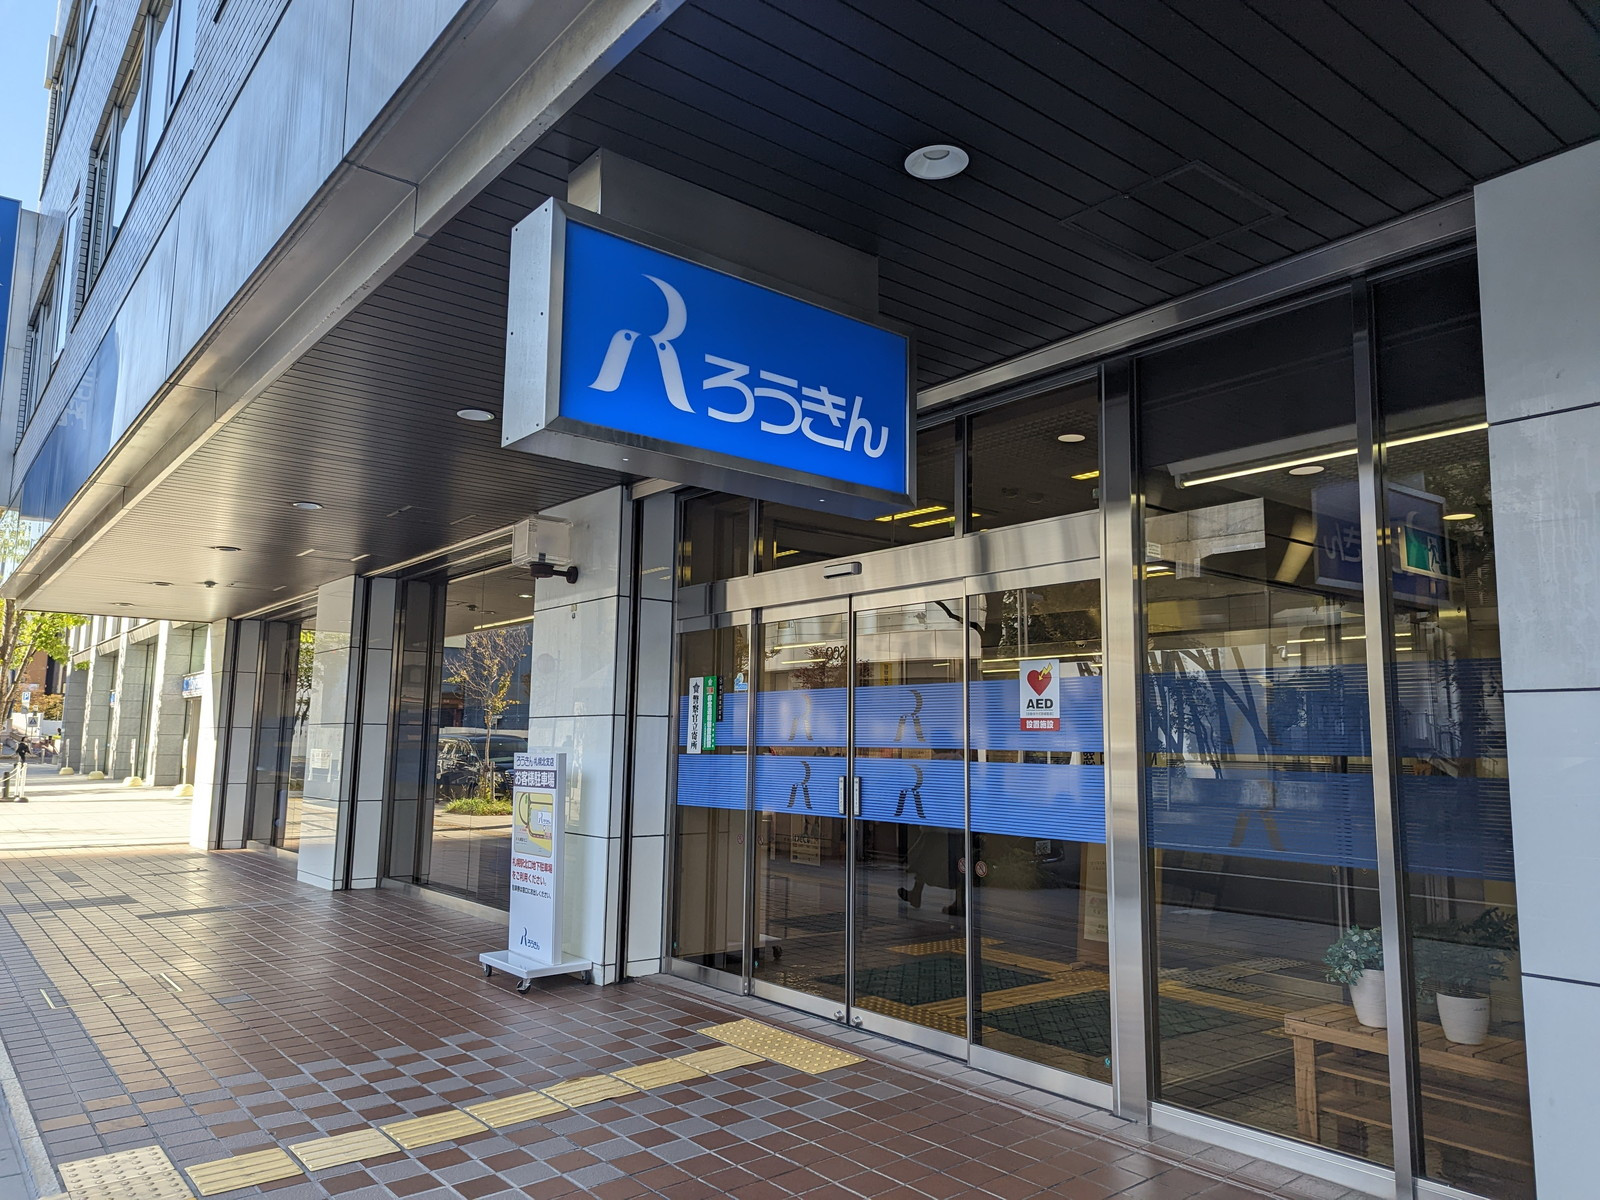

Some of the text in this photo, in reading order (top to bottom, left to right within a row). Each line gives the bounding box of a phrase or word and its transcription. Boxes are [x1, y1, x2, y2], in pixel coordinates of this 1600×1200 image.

[702, 353, 889, 459] ろうきん
[1026, 698, 1053, 709] AED
[690, 694, 699, 750] 警察官立寄所
[1025, 719, 1054, 729] 設置施設
[515, 770, 555, 788] お客様駐車場
